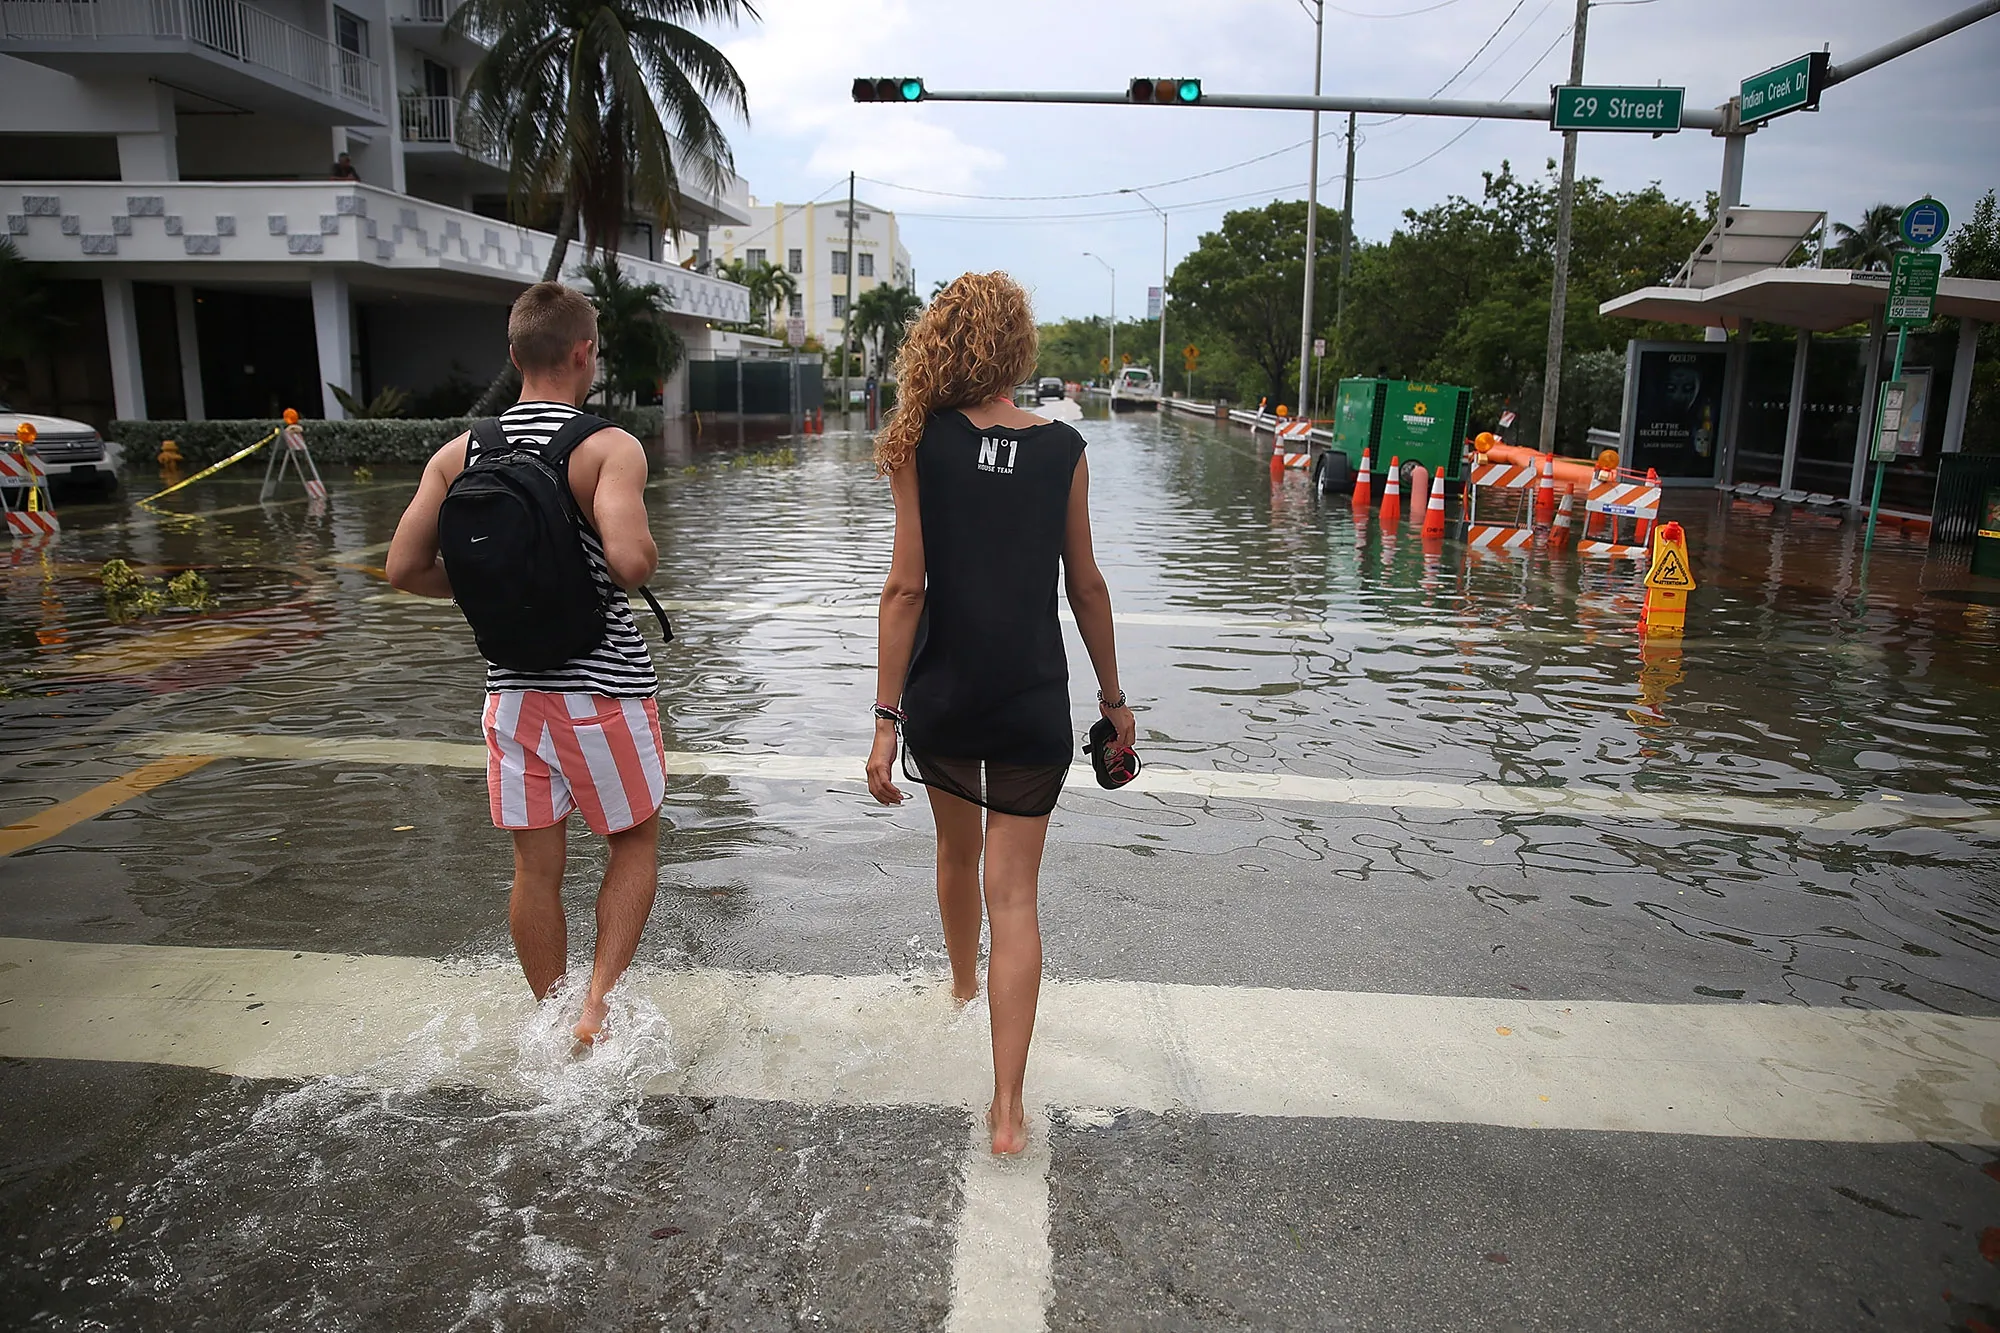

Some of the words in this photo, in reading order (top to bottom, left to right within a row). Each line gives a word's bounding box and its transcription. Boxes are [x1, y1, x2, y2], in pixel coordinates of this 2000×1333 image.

[1742, 90, 1764, 111] Indian
[1768, 77, 1791, 100] Creek
[1796, 72, 1806, 92] Dr
[1573, 97, 1598, 118] 29
[1608, 97, 1664, 120] Street
[1899, 255, 1909, 266] C
[1897, 266, 1905, 276] L
[1895, 275, 1907, 286] M
[1894, 285, 1902, 295] S
[1892, 297, 1905, 307] 120
[1891, 307, 1904, 317] 150
[1651, 422, 1665, 430] LET
[1665, 422, 1680, 430] THE
[1640, 429, 1668, 437] SECRETS
[977, 463, 996, 473] HOUSE
